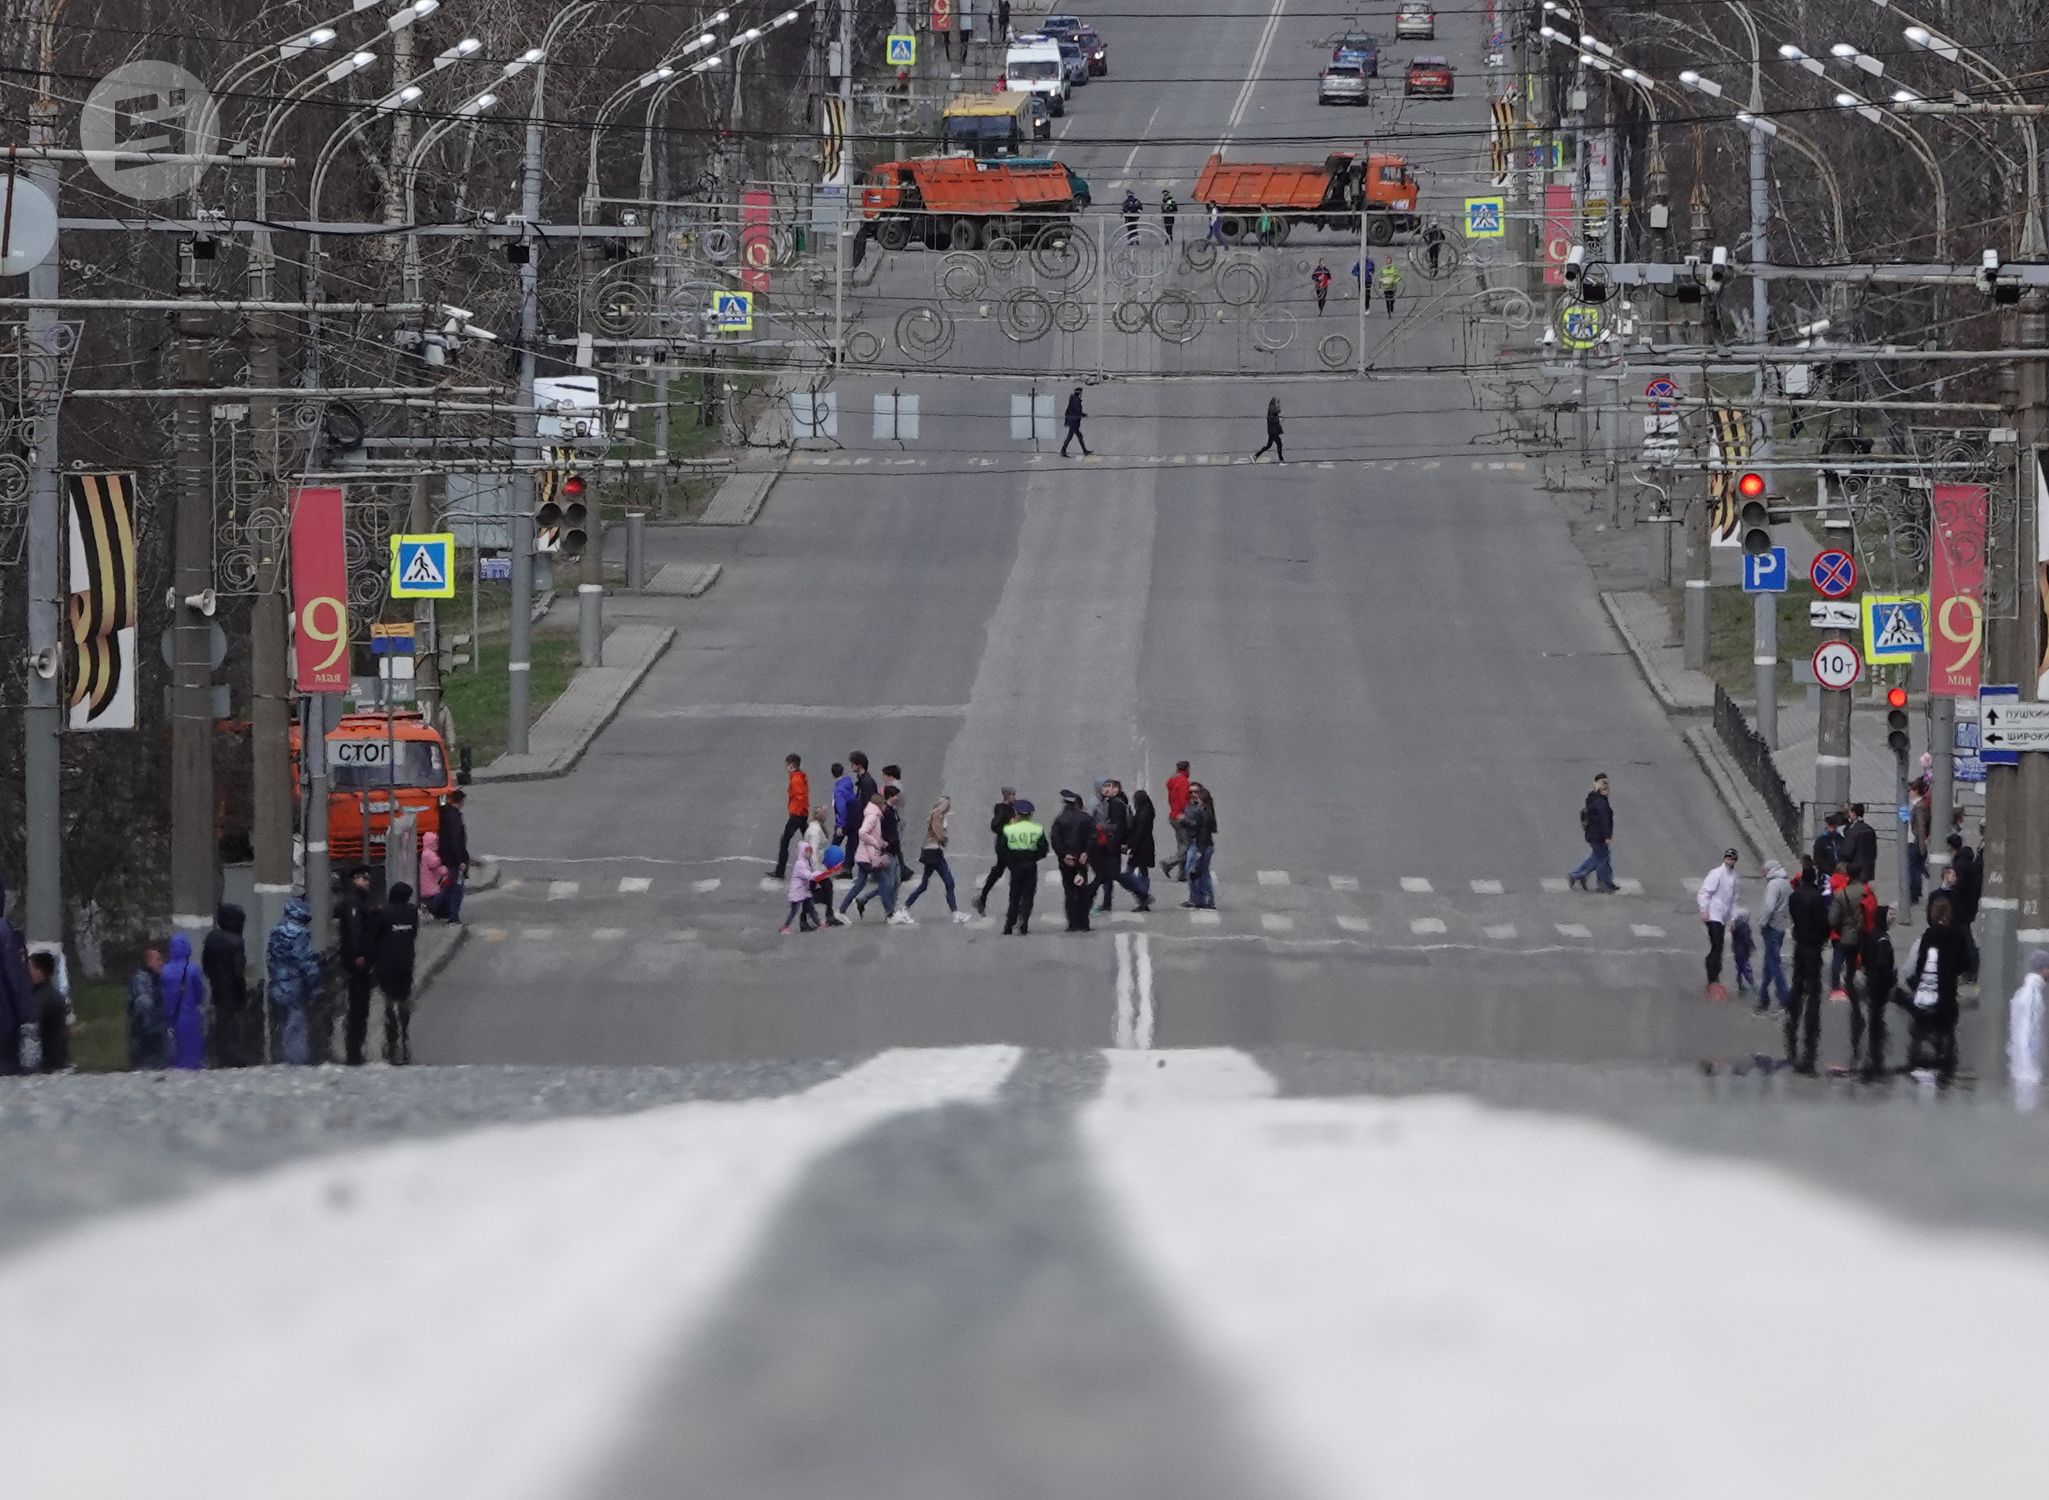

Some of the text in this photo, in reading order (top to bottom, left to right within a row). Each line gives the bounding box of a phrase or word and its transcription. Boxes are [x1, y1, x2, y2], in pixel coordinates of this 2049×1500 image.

[746, 244, 770, 280] 9
[1754, 553, 1777, 586] P
[302, 596, 347, 672] 9
[1938, 595, 1983, 673] 9
[314, 673, 342, 684] мая
[1947, 674, 1972, 686] мая
